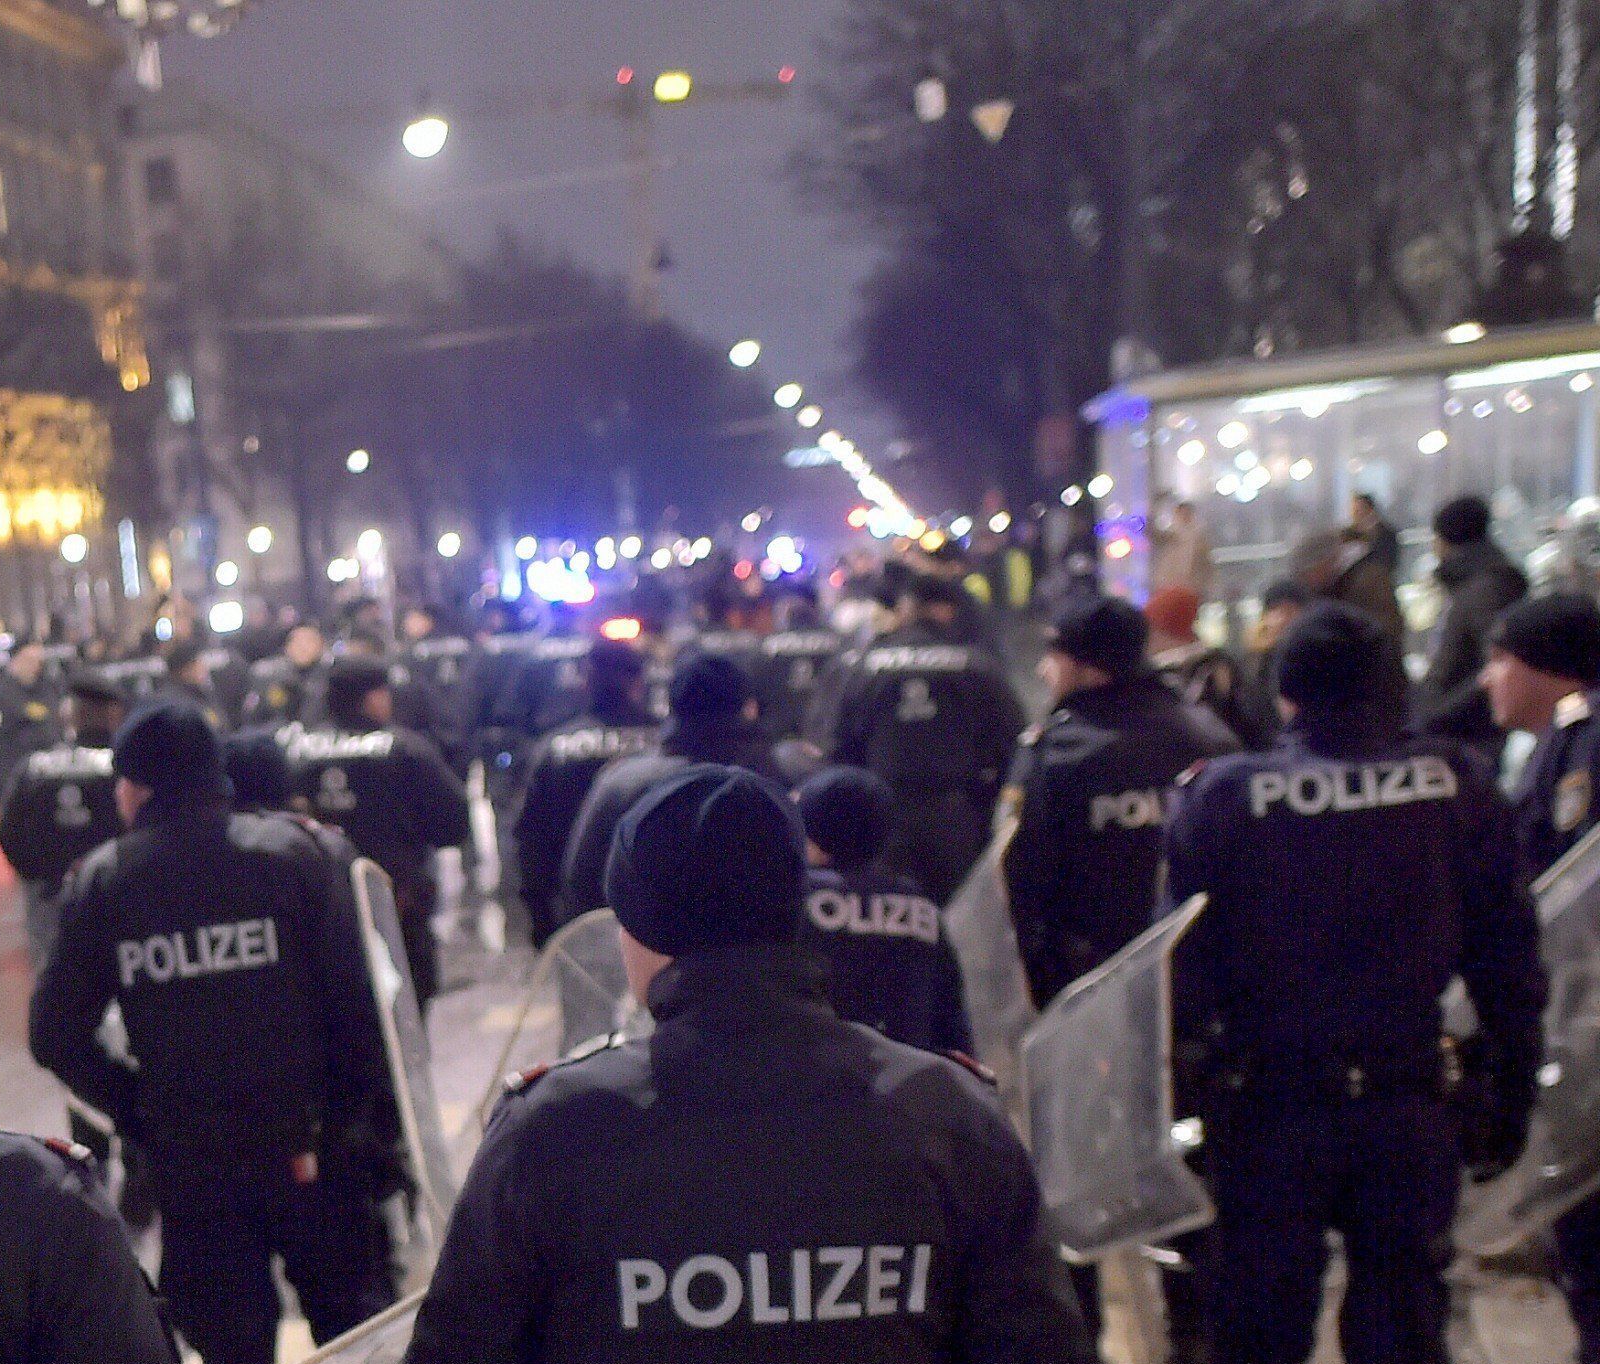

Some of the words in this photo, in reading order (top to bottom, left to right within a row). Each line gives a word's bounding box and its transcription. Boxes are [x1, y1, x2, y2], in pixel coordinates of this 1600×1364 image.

[1089, 790, 1166, 831] POL
[1250, 756, 1458, 818] POLIZEI
[806, 889, 940, 943] OLIZEI
[117, 916, 280, 987] POLIZEI
[618, 1244, 932, 1329] POLIZEI
